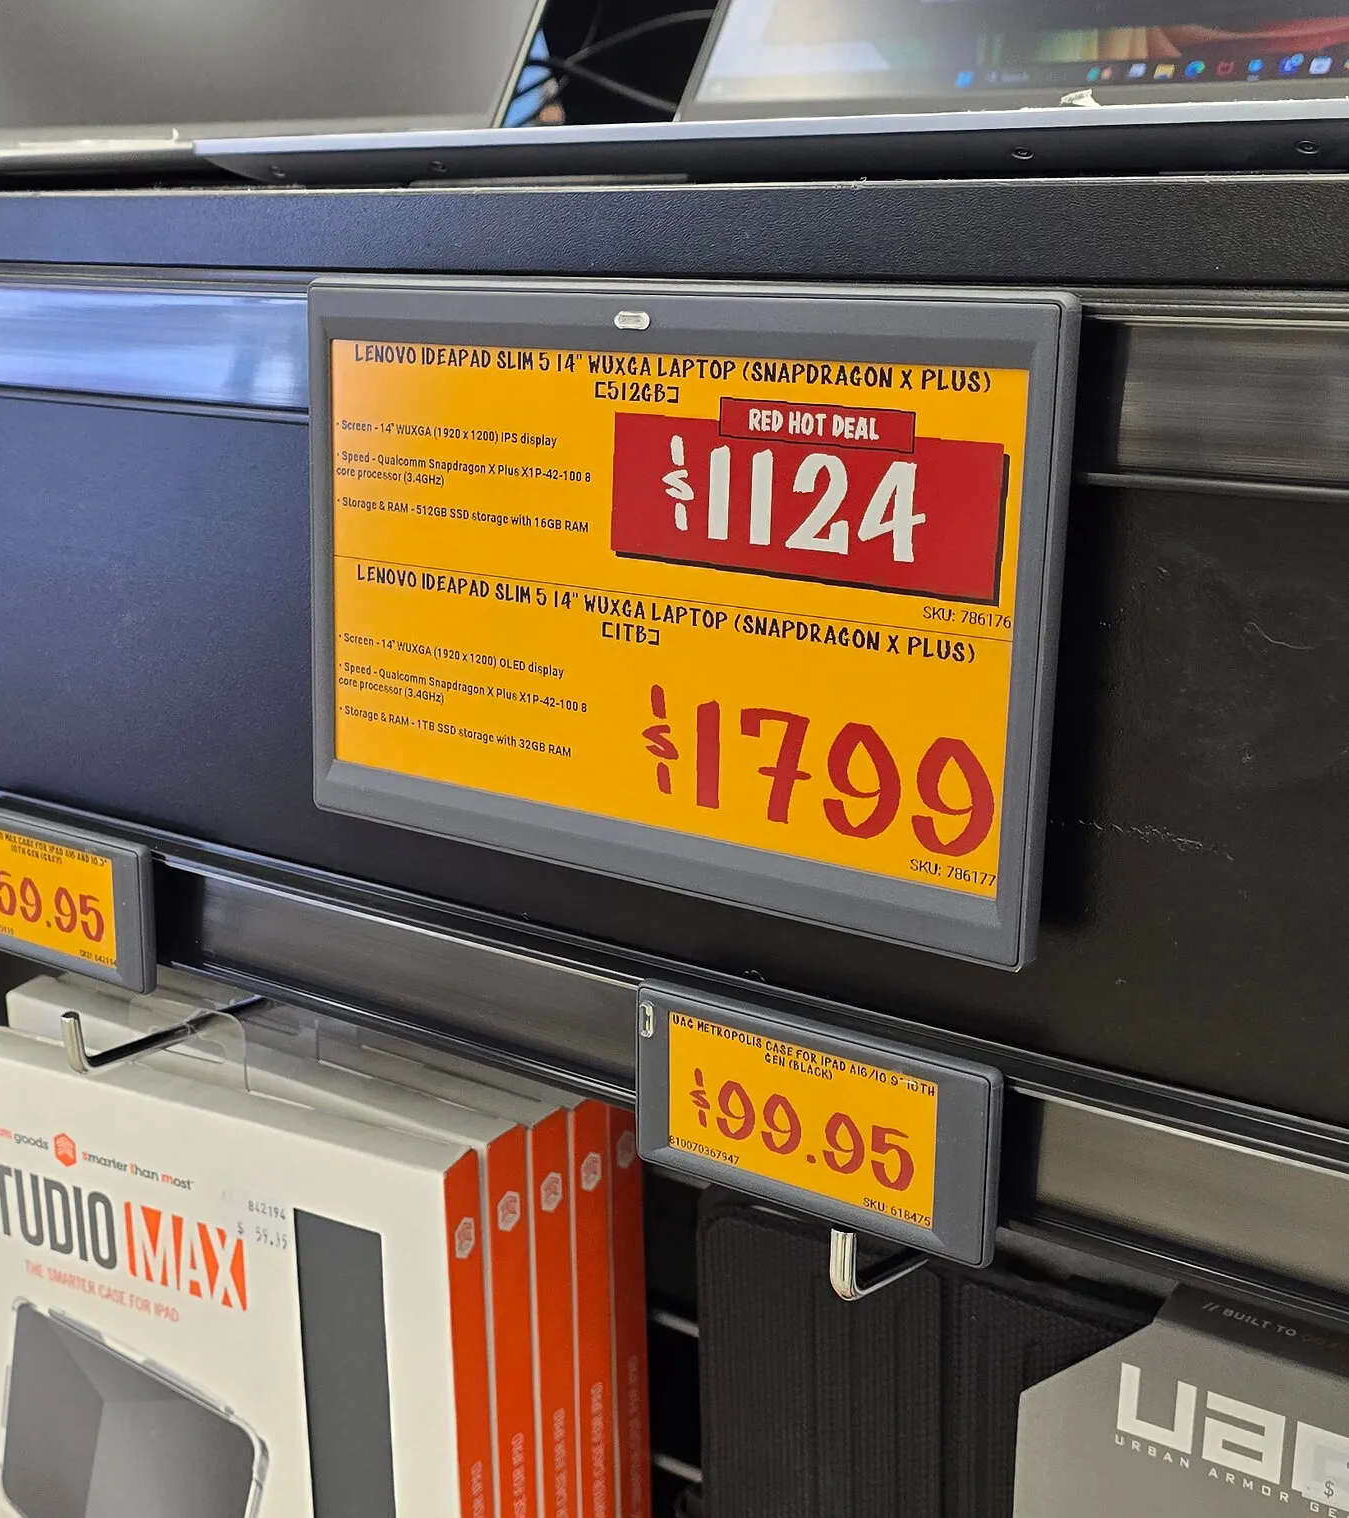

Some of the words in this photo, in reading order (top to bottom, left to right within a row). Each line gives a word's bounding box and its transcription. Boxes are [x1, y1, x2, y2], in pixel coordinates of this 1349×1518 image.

[355, 344, 416, 364] LENOVO
[422, 347, 491, 368] IDEAPAD
[497, 350, 533, 371] SLIM
[539, 352, 550, 371] 5
[557, 353, 582, 373] 14"
[588, 355, 651, 377] WUXGA
[657, 357, 736, 380] LAPTOP
[743, 362, 892, 388] (SNAPDRAGON
[900, 368, 913, 390] X
[921, 369, 992, 393] PLUS)
[342, 420, 372, 433] Screen
[380, 423, 394, 434] 14"
[396, 425, 432, 437] WUXGA
[434, 427, 460, 440] (1920
[463, 431, 469, 440] x
[471, 430, 499, 444] 1200)
[501, 431, 517, 444] IPS
[520, 433, 557, 448] display
[748, 408, 783, 432] RED
[788, 411, 826, 436] HOT
[832, 414, 879, 441] DEAL
[337, 467, 355, 477] core
[357, 469, 401, 484] processor
[404, 472, 445, 488] (3.4GHz)
[342, 451, 369, 465] Speed
[377, 454, 426, 469] Qualcomm
[429, 458, 485, 476] Snapdragon
[488, 464, 495, 474] X
[498, 464, 519, 477] Plus
[521, 467, 582, 482] X1P-42-100
[585, 472, 591, 482] 8
[342, 497, 377, 511] Storage
[379, 501, 385, 510] &
[387, 501, 408, 513] RAM
[416, 504, 447, 517] 512GB
[449, 508, 469, 520] SSD
[471, 510, 508, 525] storage
[511, 514, 531, 527] with
[535, 517, 562, 530] 16GB
[565, 520, 589, 533] RAM
[663, 435, 926, 563] $1124
[357, 564, 416, 588] LENOVO
[421, 575, 489, 598] IDEAPAD
[495, 583, 530, 604] SLIM
[536, 587, 547, 606] 5
[555, 590, 578, 610] 14"
[584, 594, 645, 620] WUXGA
[651, 602, 727, 630] LAPTOP
[734, 613, 880, 650] (SNAPDRAGON
[887, 634, 899, 654] X
[908, 635, 976, 664] PLUS)
[922, 606, 955, 622] SKU:
[961, 609, 1012, 629] 786176
[344, 633, 373, 647] Screen
[381, 639, 395, 649] 14"
[397, 641, 431, 656] WUXGA
[434, 646, 460, 662] (1920
[462, 653, 468, 662] x
[471, 653, 497, 669] 1200)
[499, 658, 525, 671] OLED
[528, 662, 564, 680] display
[339, 676, 357, 687] core
[360, 680, 402, 696] processor
[405, 687, 444, 706] (3.4GHz)
[344, 662, 371, 677] Speed
[379, 668, 426, 685] Qualcomm
[429, 676, 485, 696] Snapdragon
[487, 686, 494, 696] X
[497, 688, 517, 700] Plus
[519, 691, 578, 712] X1P-42-100
[581, 702, 587, 712] 8
[345, 705, 378, 721] Storage
[381, 713, 387, 722] &
[389, 714, 409, 727] RAM
[417, 720, 435, 731] 1TB
[437, 723, 456, 735] SSD
[459, 727, 494, 744] storage
[496, 733, 516, 747] with
[519, 738, 545, 752] 32GB
[548, 744, 571, 758] RAM
[641, 684, 996, 857] $1799
[35, 839, 47, 852] FOR
[909, 857, 941, 878] SKU:
[946, 866, 997, 888] 786177
[673, 1014, 693, 1029] UAG
[697, 1021, 762, 1048] METROPOLIS
[765, 1041, 793, 1056] CASE
[796, 1049, 817, 1064] FOR
[821, 1055, 846, 1071] IPAD
[765, 1054, 786, 1069] GEN
[789, 1059, 833, 1080] (BLACK)
[14, 1131, 49, 1150] goods
[690, 1068, 914, 1192] $99.95
[82, 1151, 127, 1172] smarter
[130, 1162, 159, 1182] than
[863, 1197, 888, 1215] SKU:
[890, 1204, 931, 1227] 618475
[124, 1201, 248, 1312] MAX
[25, 1260, 44, 1278] THE
[47, 1267, 95, 1295] SMARTER
[99, 1282, 125, 1305] CASE
[129, 1292, 150, 1312] FOR
[1223, 1308, 1271, 1328] BUILT
[1276, 1325, 1297, 1336] TO
[1115, 1434, 1190, 1469] URBAN
[1208, 1467, 1289, 1503] ARMOR
